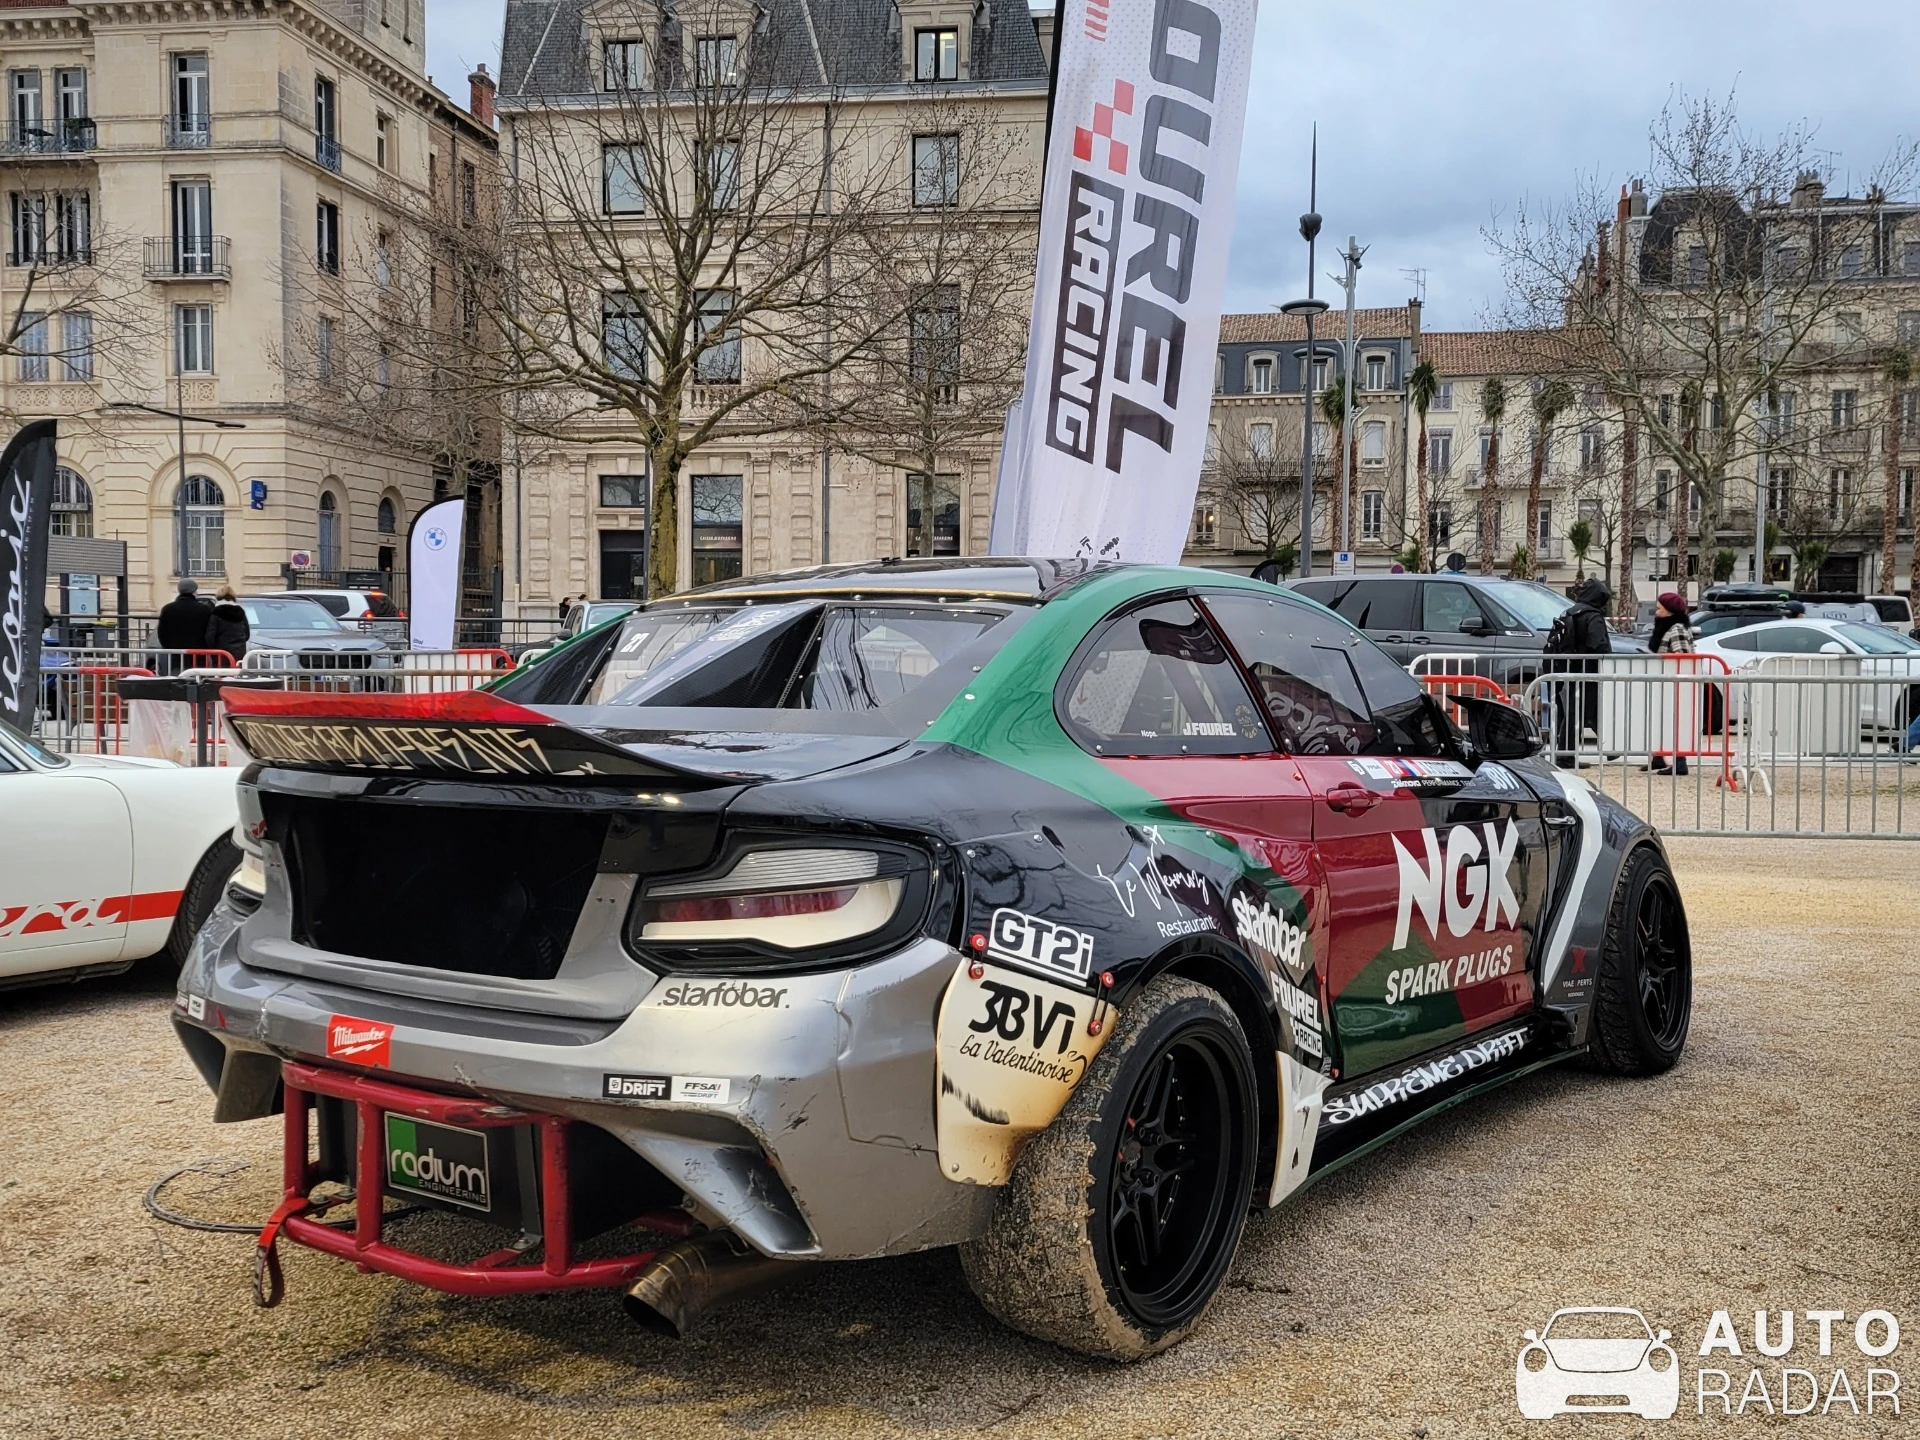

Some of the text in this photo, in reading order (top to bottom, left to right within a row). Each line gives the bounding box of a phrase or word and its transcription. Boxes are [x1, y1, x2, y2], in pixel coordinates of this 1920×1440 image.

[1050, 186, 1115, 450] RACING
[1182, 722, 1237, 736] J.FOUREL
[1390, 815, 1521, 952] NGK
[1156, 915, 1217, 938] Restaurant
[1385, 944, 1514, 1005] SPARK PLUGS
[1270, 969, 1323, 1032] FOUREL
[332, 1025, 387, 1048] Milwaukee
[1299, 1027, 1322, 1053] RACING
[984, 1039, 1074, 1083] Valentinoise
[622, 1082, 666, 1097] DRIFT
[684, 1082, 717, 1091] FFSA
[390, 1147, 486, 1195] radium
[418, 1179, 487, 1203] ENGINEERING
